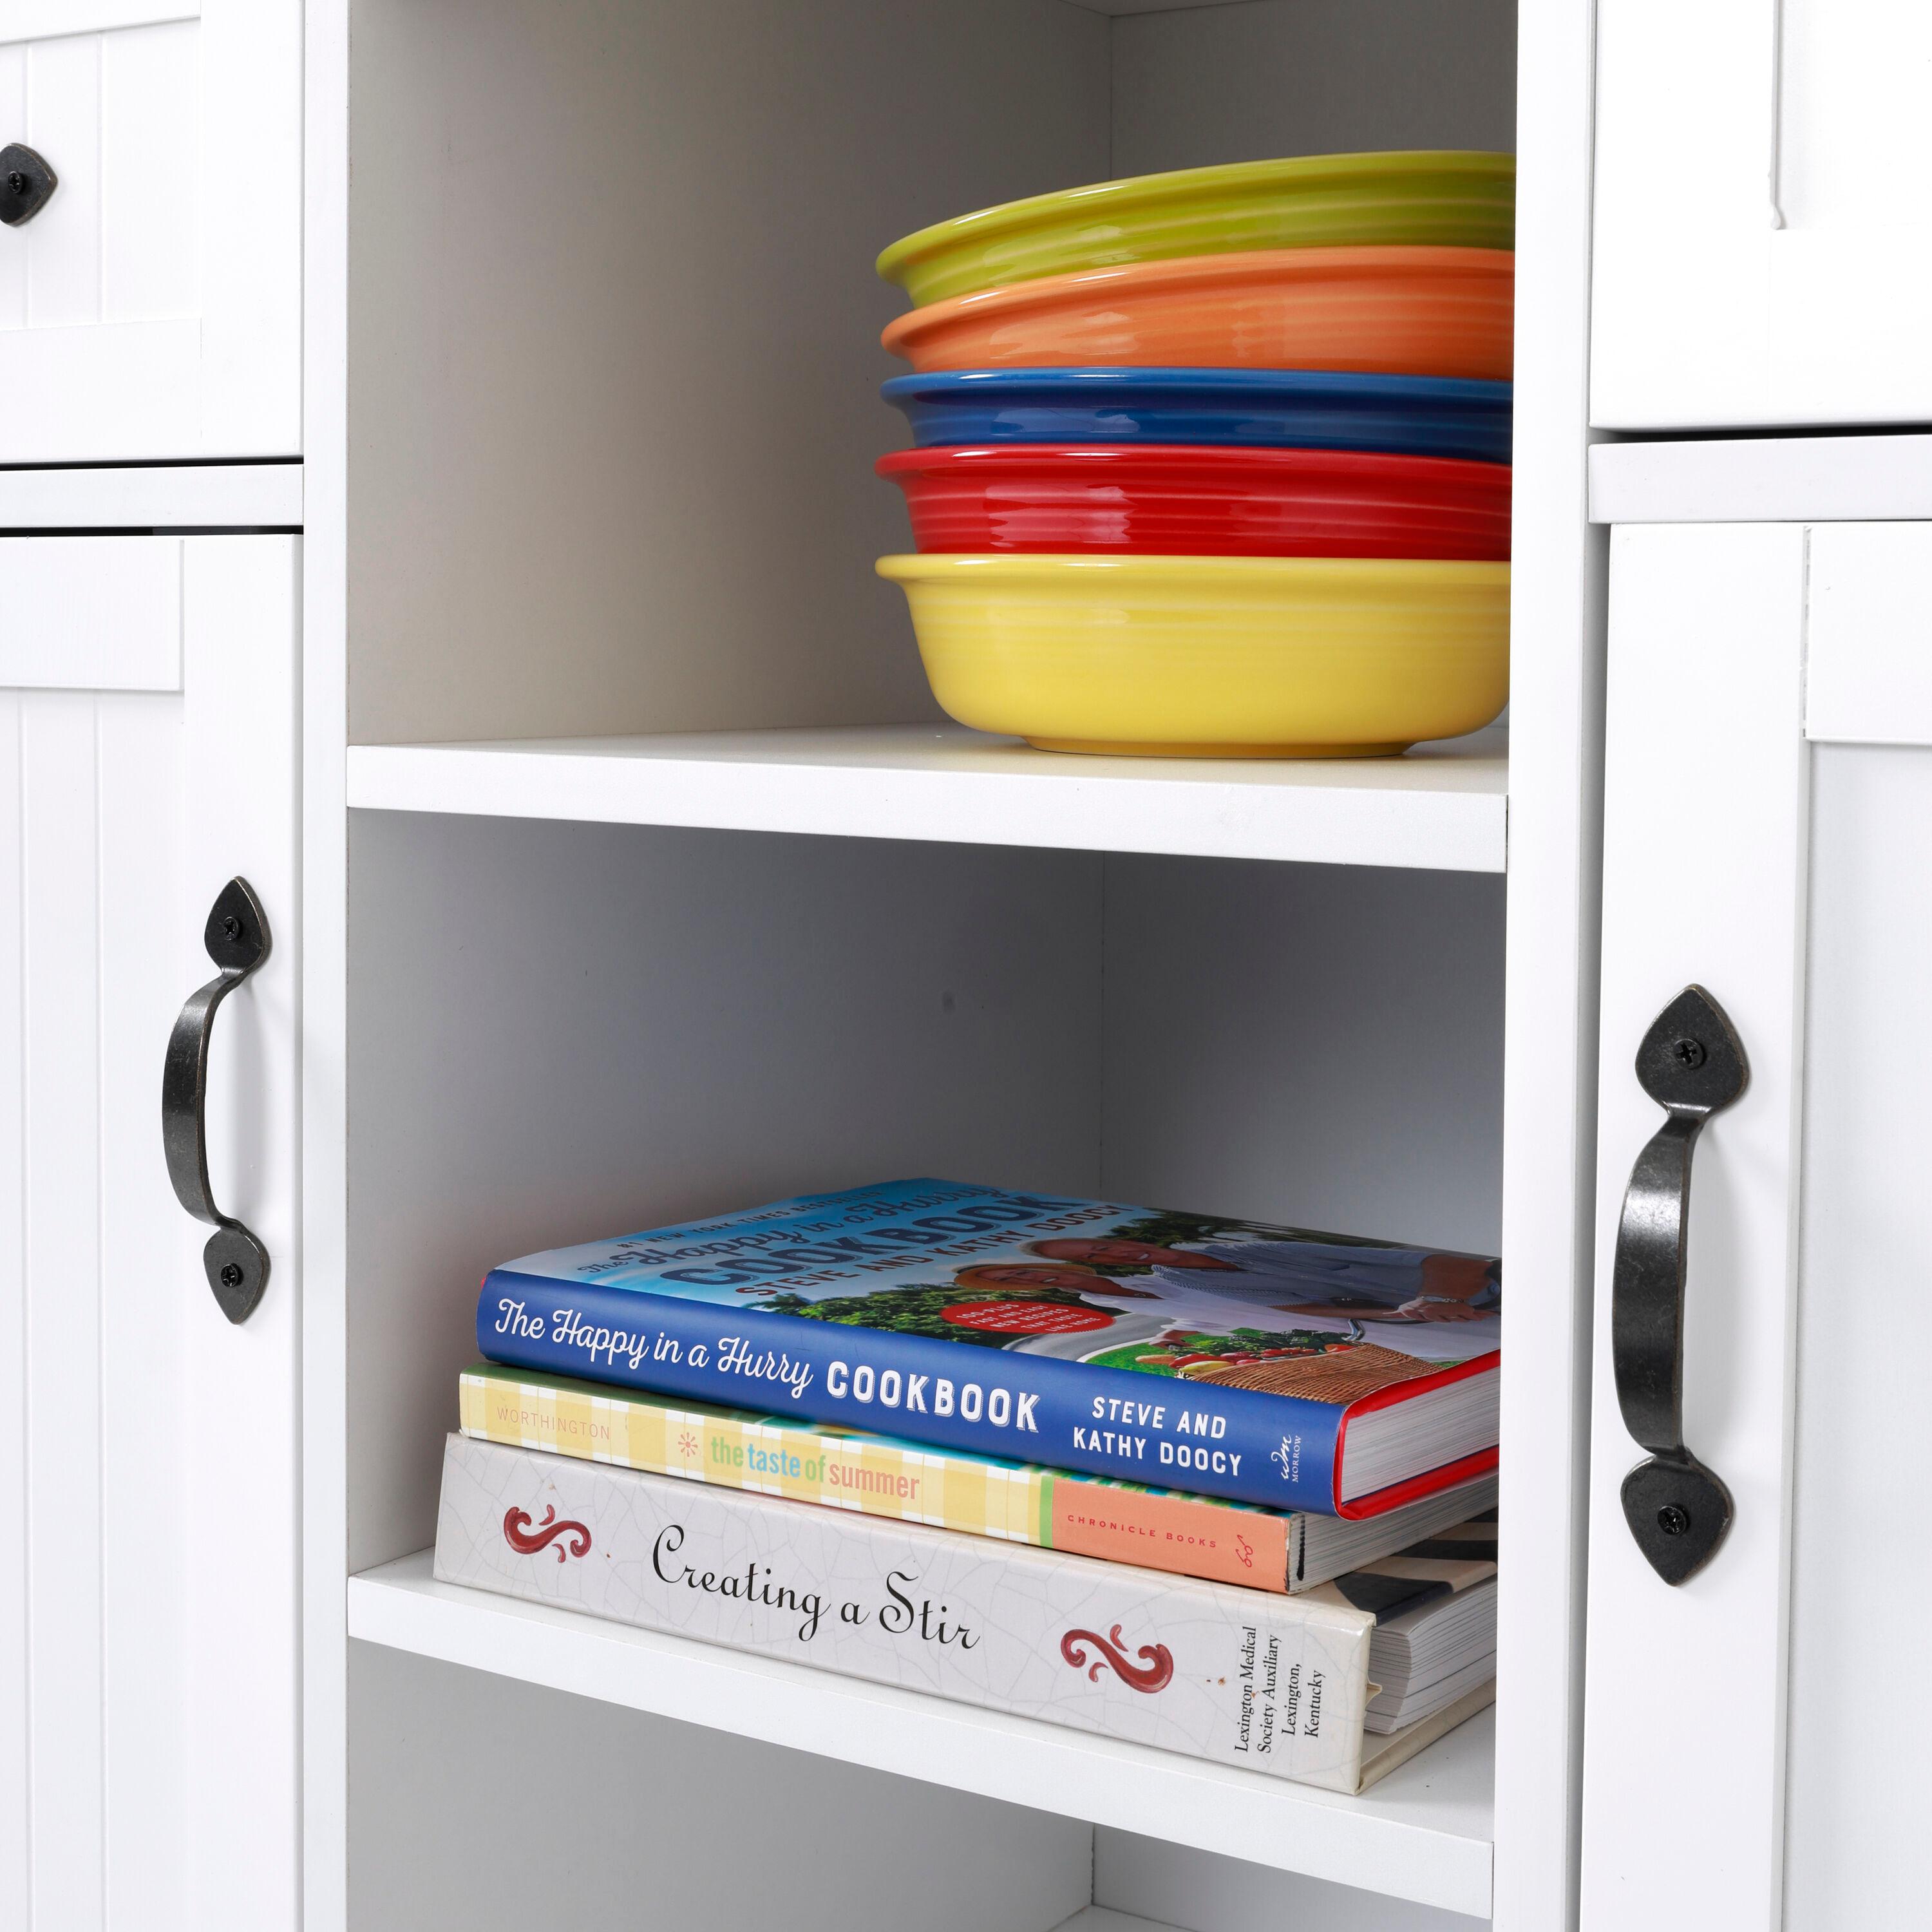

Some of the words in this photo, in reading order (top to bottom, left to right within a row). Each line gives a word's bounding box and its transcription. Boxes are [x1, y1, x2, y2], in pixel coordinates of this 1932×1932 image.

[793, 1222, 845, 1233] in
[843, 1215, 874, 1224] a
[844, 1188, 1009, 1217] Hurry
[609, 1229, 810, 1265] Happy
[617, 1240, 644, 1249] #1
[645, 1231, 686, 1244] NEW
[688, 1222, 739, 1235] YORK
[737, 1209, 791, 1224] TIMES
[660, 1196, 1092, 1285] COOKBOOK
[735, 1270, 862, 1296] STEVE
[854, 1255, 934, 1272] AND
[925, 1229, 1035, 1256] KATHY
[1025, 1204, 1134, 1231] DOOCY
[577, 1260, 629, 1273] The
[495, 1298, 545, 1339] The
[552, 1309, 649, 1370] Happy
[653, 1332, 683, 1364] in
[687, 1343, 710, 1368] a
[717, 1336, 814, 1399] Hurry
[827, 1361, 1041, 1434] COOKBOOK
[497, 1406, 611, 1441] WORTHINGTON
[1092, 1396, 1166, 1430] STEVE
[1176, 1410, 1227, 1439] AND
[711, 1436, 744, 1468] the
[747, 1443, 801, 1478] taste
[804, 1455, 826, 1482] of
[828, 1461, 920, 1501] summer
[1073, 1426, 1146, 1460] KATHY
[1160, 1441, 1242, 1477] DOOCY
[1292, 1435, 1302, 1483] MORROW
[1067, 1515, 1156, 1537] CHRONICLE
[1166, 1533, 1217, 1548] BOOKS
[652, 1524, 832, 1642] Creating
[840, 1602, 871, 1625] a
[879, 1571, 981, 1650] Stir
[1239, 1625, 1256, 1680] Medical
[1261, 1634, 1282, 1700] Auxiliary
[1234, 1684, 1255, 1752] Lexington
[1282, 1663, 1302, 1736] Lexington,
[1304, 1669, 1327, 1738] Kentucky
[1257, 1703, 1278, 1754] Society
